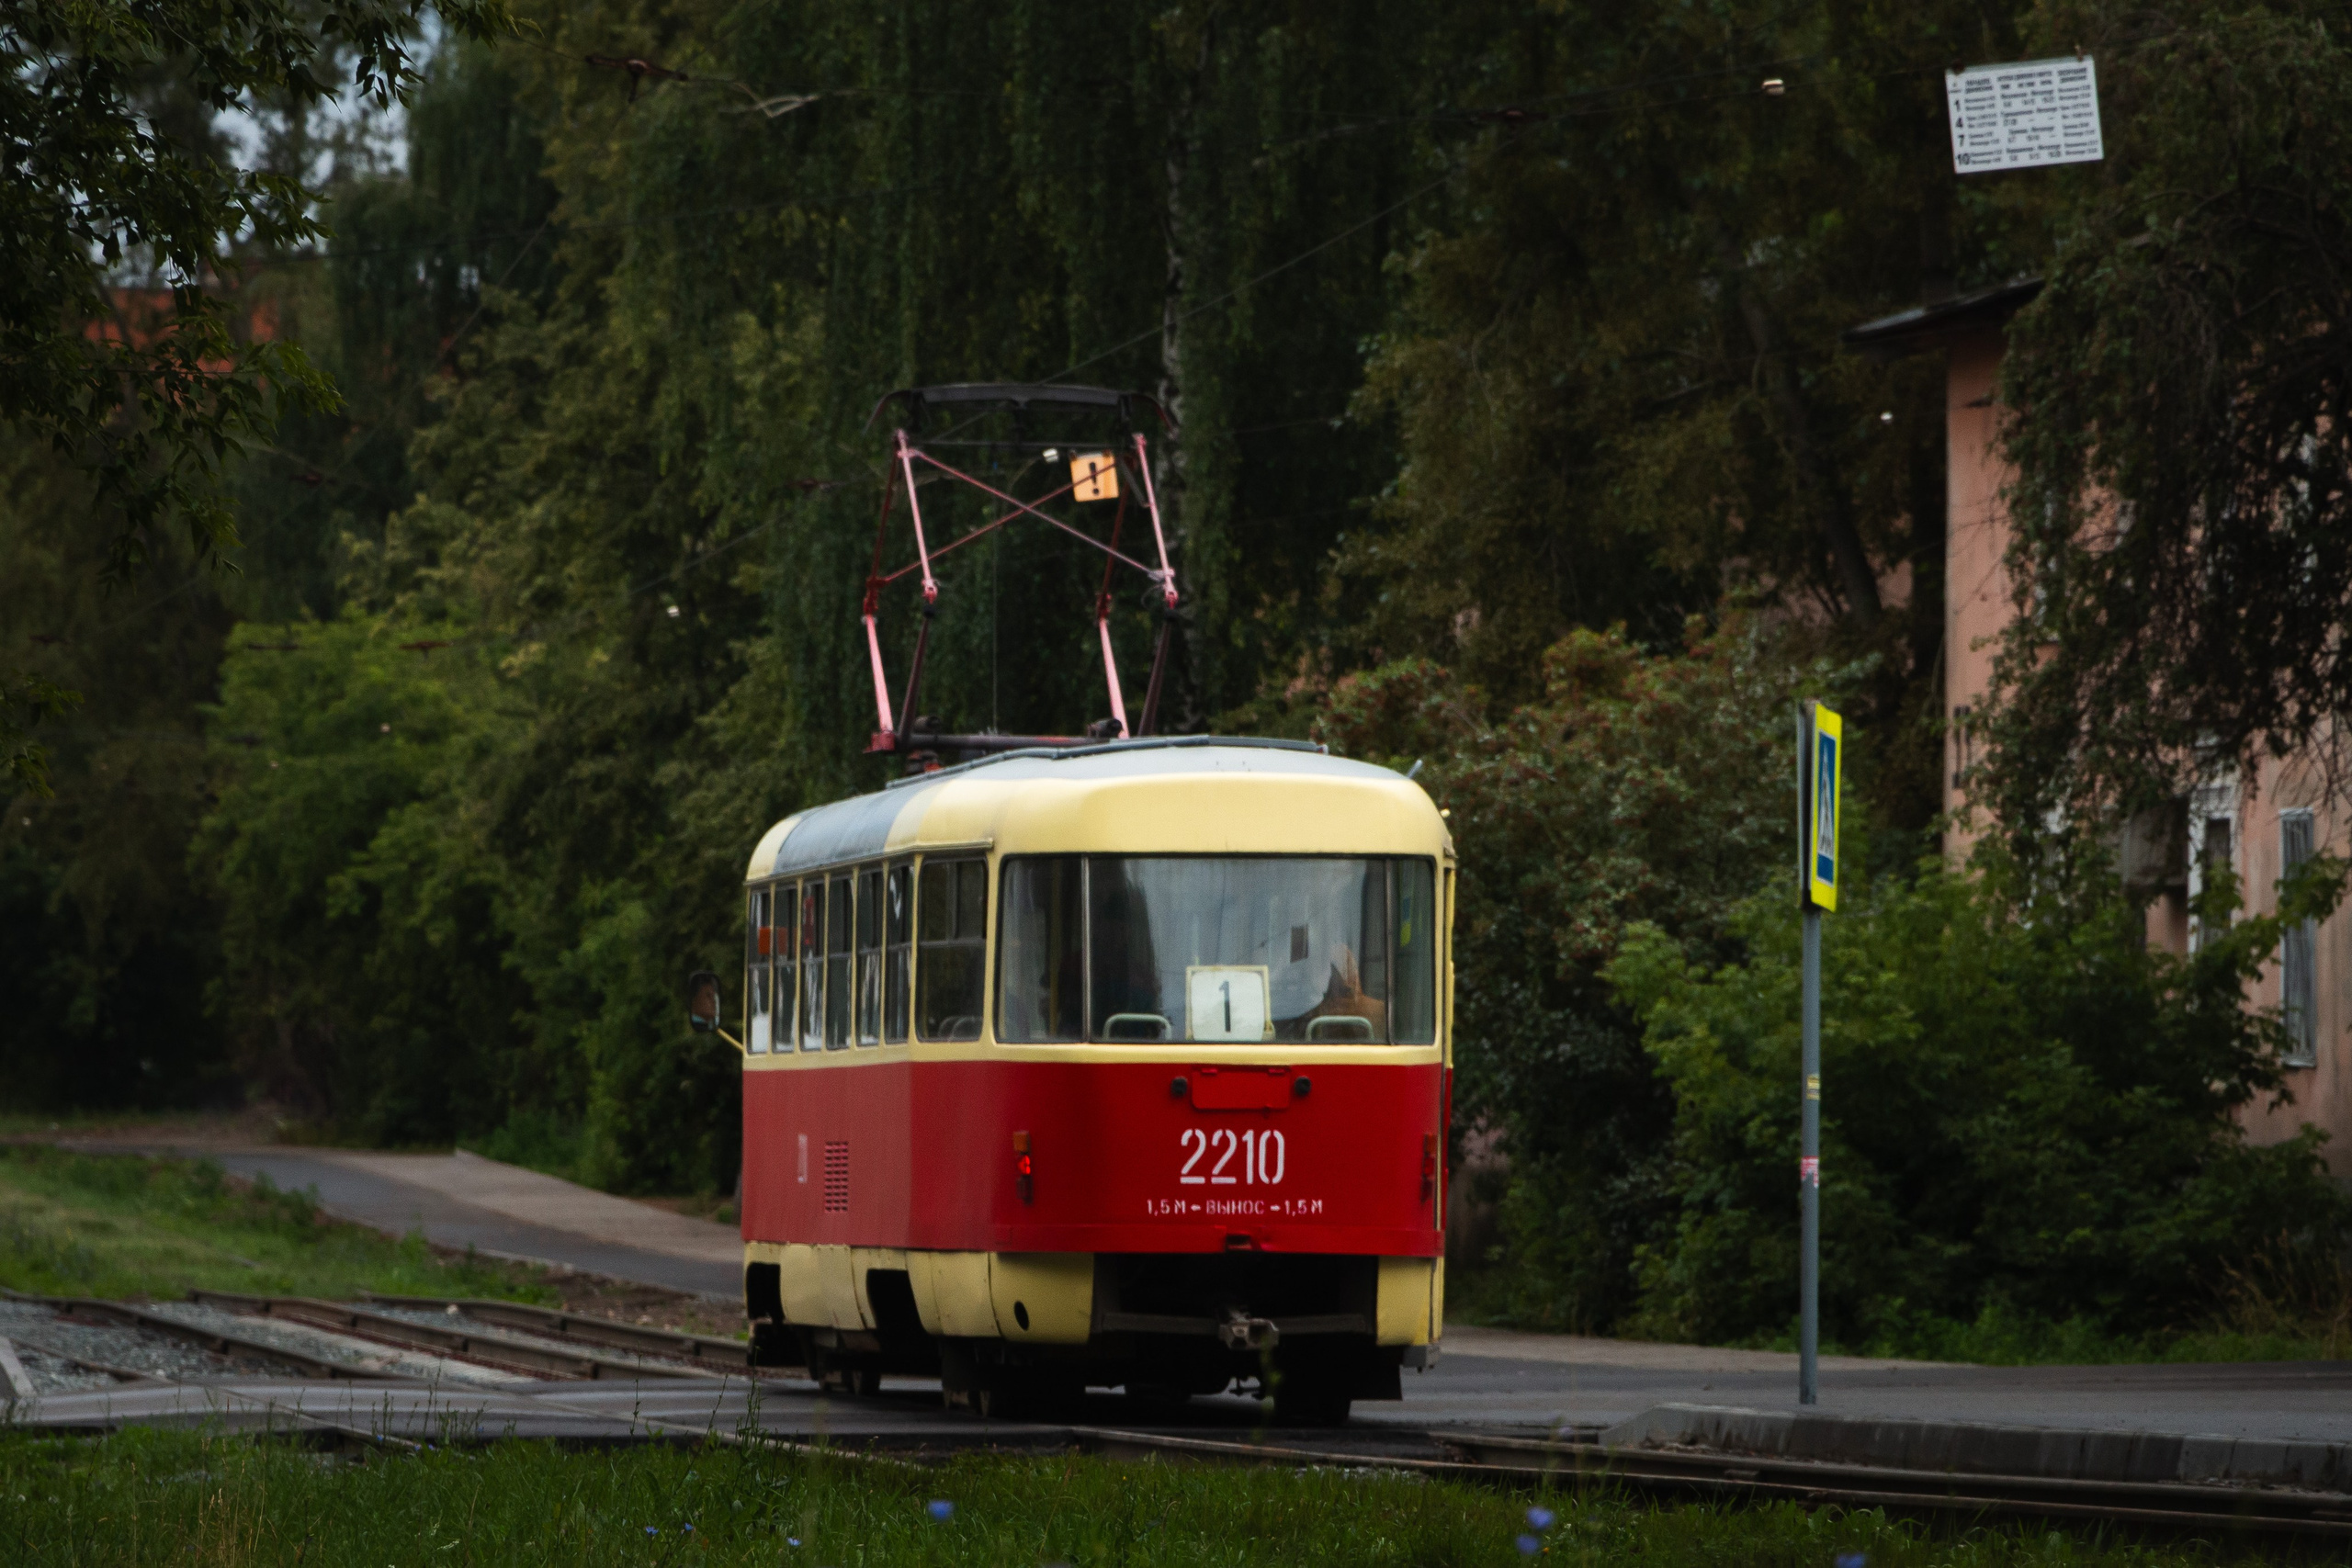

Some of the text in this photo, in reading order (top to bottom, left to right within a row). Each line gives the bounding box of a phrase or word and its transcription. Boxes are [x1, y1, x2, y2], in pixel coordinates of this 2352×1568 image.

[1953, 98, 1962, 112] 1
[1955, 117, 1963, 129] 4
[1958, 134, 1965, 147] 7
[1218, 980, 1231, 1032] 1
[1180, 1129, 1285, 1185] 2210
[1205, 1199, 1265, 1215] ВЫНОС
